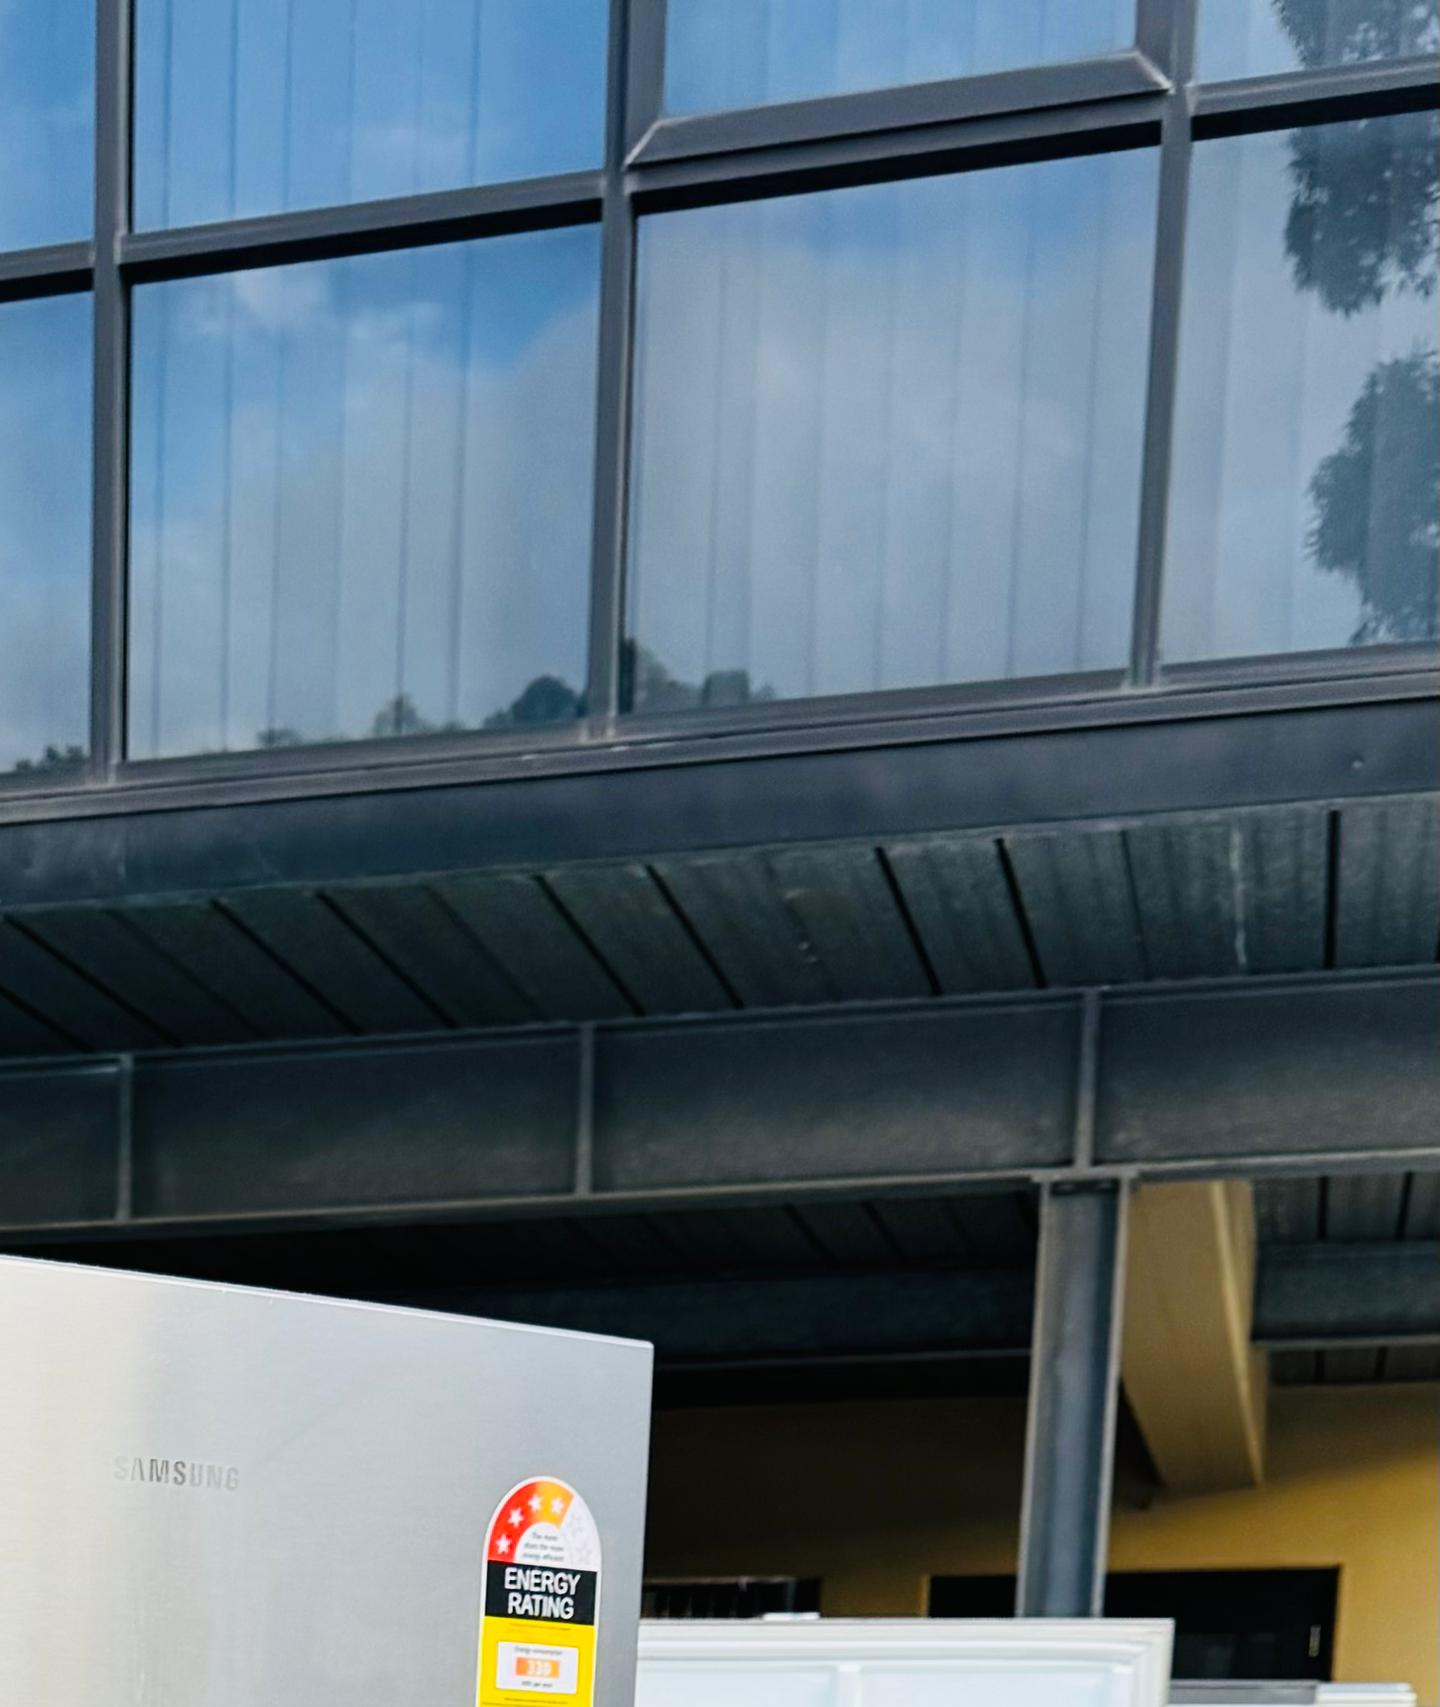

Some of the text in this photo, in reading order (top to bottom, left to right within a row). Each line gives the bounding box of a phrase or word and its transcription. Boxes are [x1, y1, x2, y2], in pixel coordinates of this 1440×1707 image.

[113, 1456, 240, 1491] SAMSUNG
[504, 1566, 581, 1596] ENERGY
[507, 1591, 575, 1620] RATING
